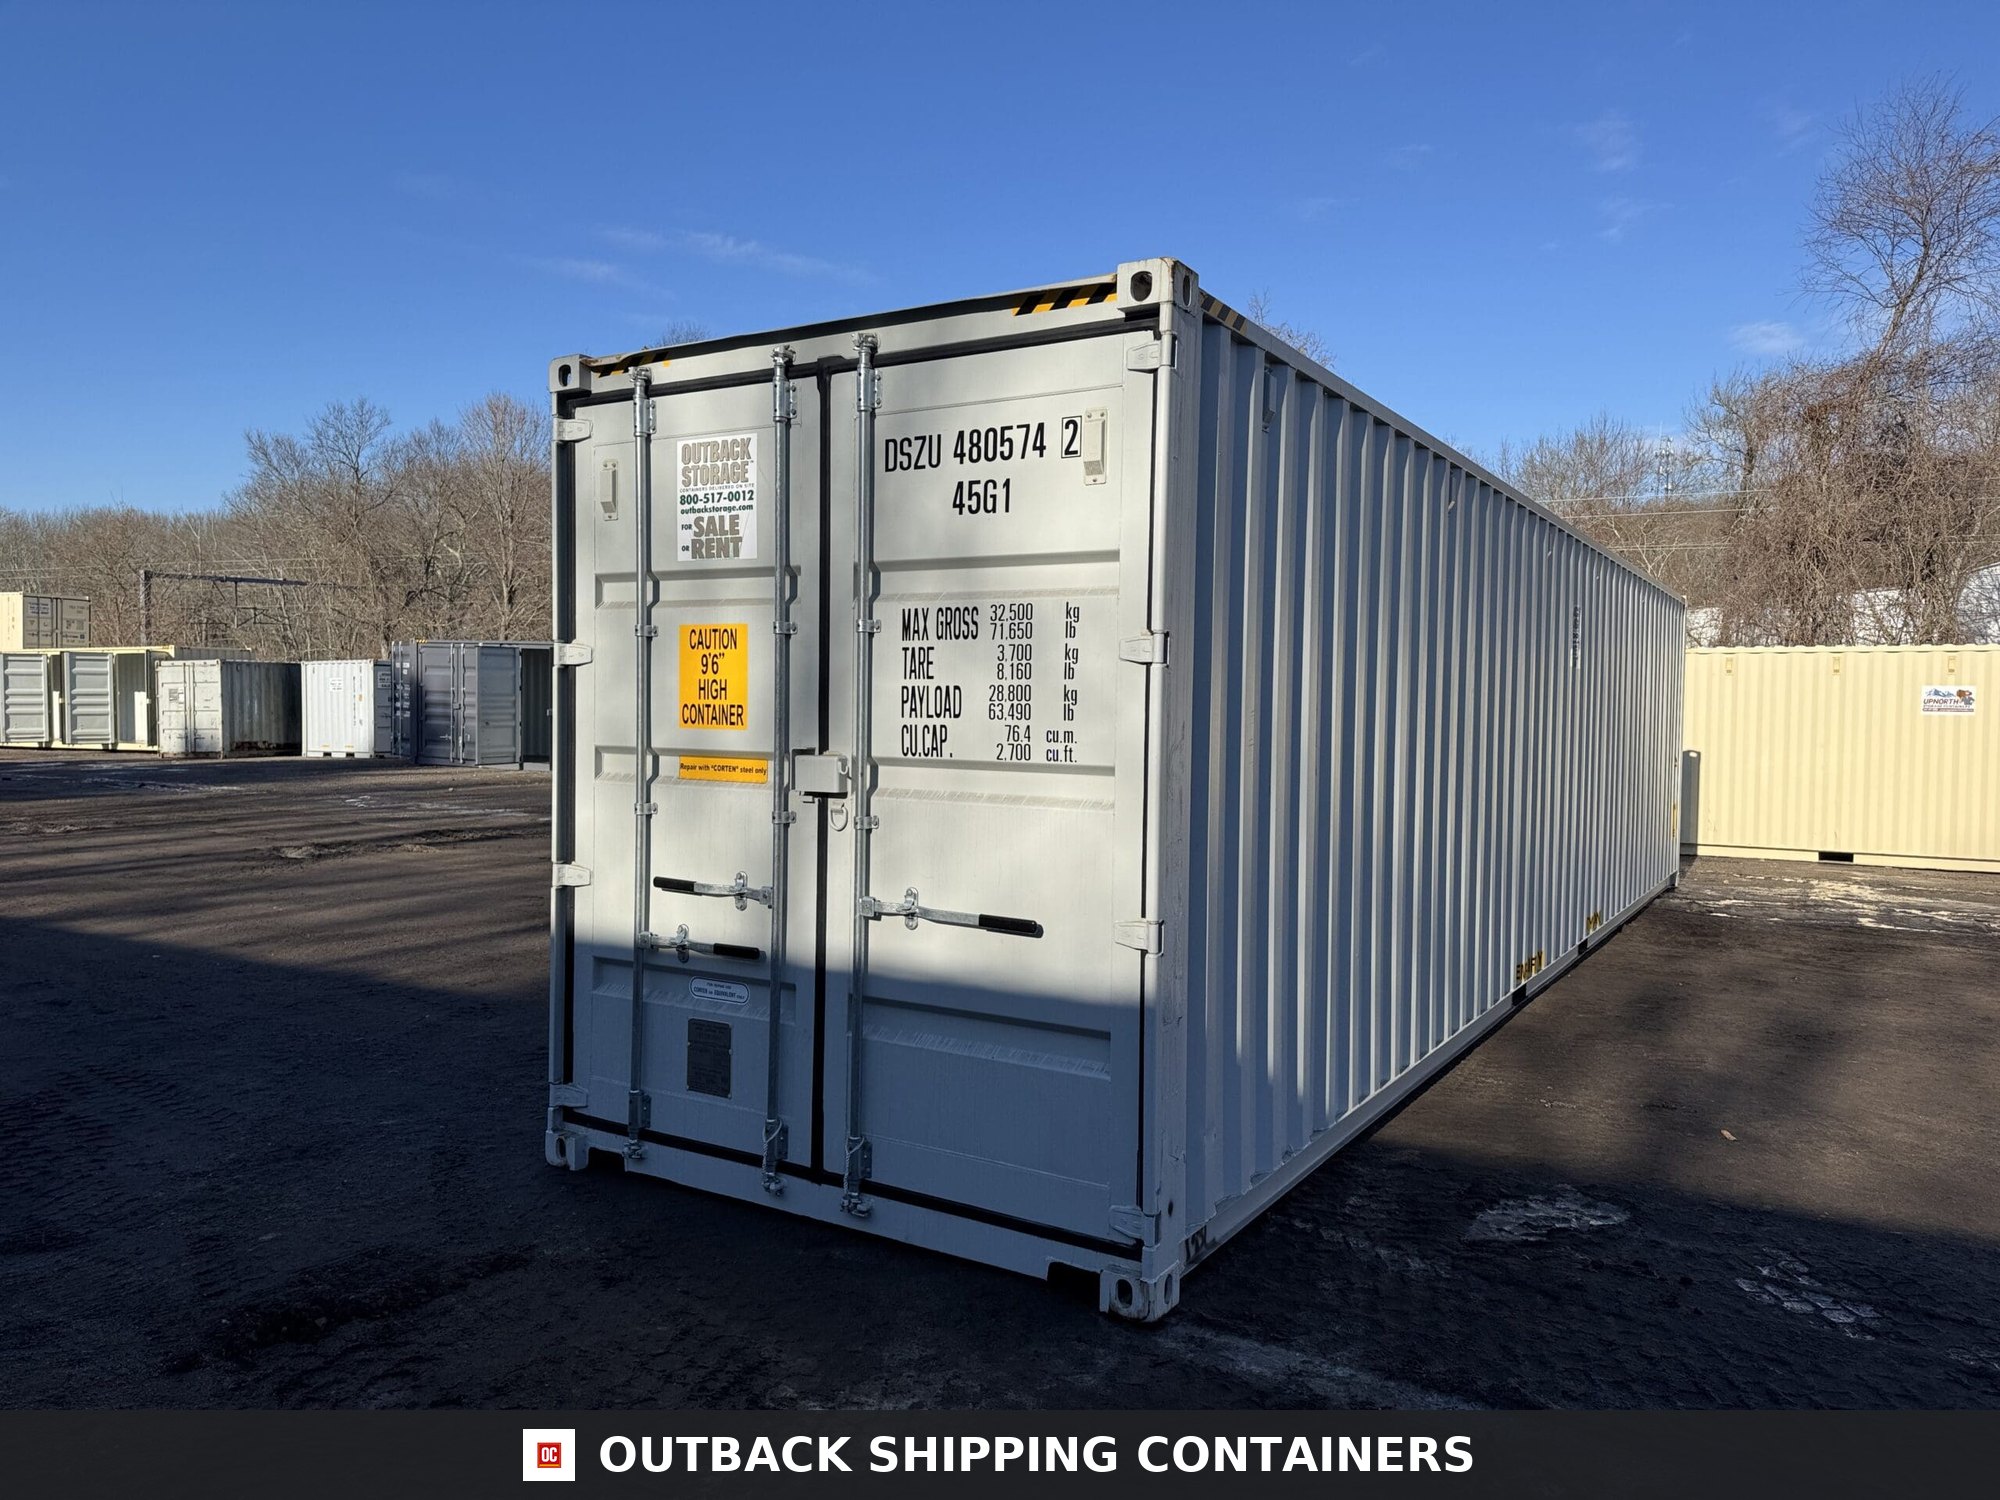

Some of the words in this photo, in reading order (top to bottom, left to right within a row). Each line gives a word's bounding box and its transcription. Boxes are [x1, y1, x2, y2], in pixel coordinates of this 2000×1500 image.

[681, 437, 751, 465] OUTBACK
[884, 434, 942, 473] DSZU
[953, 422, 1046, 464] 480574
[1064, 419, 1079, 456] 2
[681, 460, 749, 487] STORAGE
[679, 490, 754, 505] 800-517-0012
[952, 478, 1011, 515] 45G1
[680, 504, 754, 515] outbackstorage.com
[693, 514, 740, 538] SALE
[691, 536, 743, 559] RENT
[902, 607, 929, 641] MAX
[936, 606, 979, 641] GROSS
[990, 603, 1033, 622] 32,500
[1065, 601, 1080, 623] kg
[990, 621, 1033, 640] 71,650
[1065, 621, 1076, 639] lb
[689, 628, 737, 650] CAUTION
[902, 646, 935, 680] TARE
[1064, 643, 1079, 664] kg
[1063, 662, 1075, 680] lb
[698, 679, 727, 700] HIGH
[901, 685, 962, 719] PAYLOAD
[988, 684, 1032, 703] 28,800
[1063, 684, 1078, 706] kg
[988, 703, 1031, 721] 63,490
[1063, 703, 1074, 721] lb
[681, 703, 744, 726] CONTAINER
[1004, 724, 1031, 743] 76.4
[1046, 729, 1077, 744] cu.m.
[1046, 745, 1077, 763] cu.ft.
[680, 763, 697, 772] Repair
[754, 766, 767, 775] only
